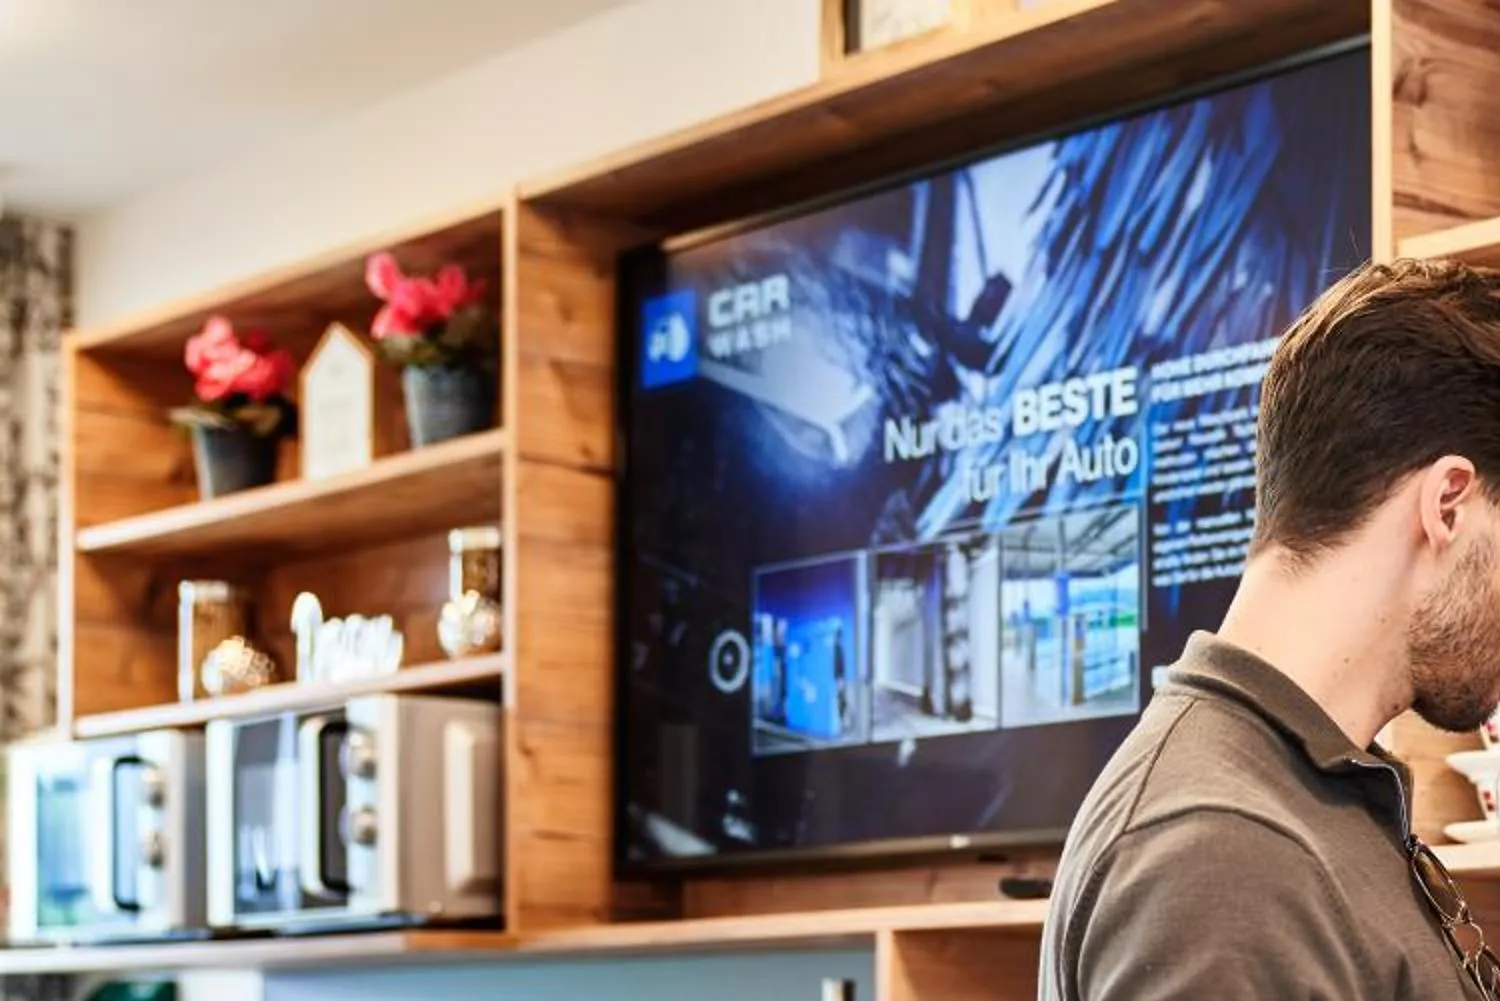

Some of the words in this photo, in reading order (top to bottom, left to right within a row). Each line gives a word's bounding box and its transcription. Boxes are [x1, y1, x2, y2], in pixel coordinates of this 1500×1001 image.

[708, 273, 791, 328] CAR
[884, 417, 938, 463] Nur
[938, 403, 1003, 450] das
[1012, 366, 1138, 437] BESTE
[1009, 448, 1049, 495] Ihr
[1056, 433, 1139, 484] Auto
